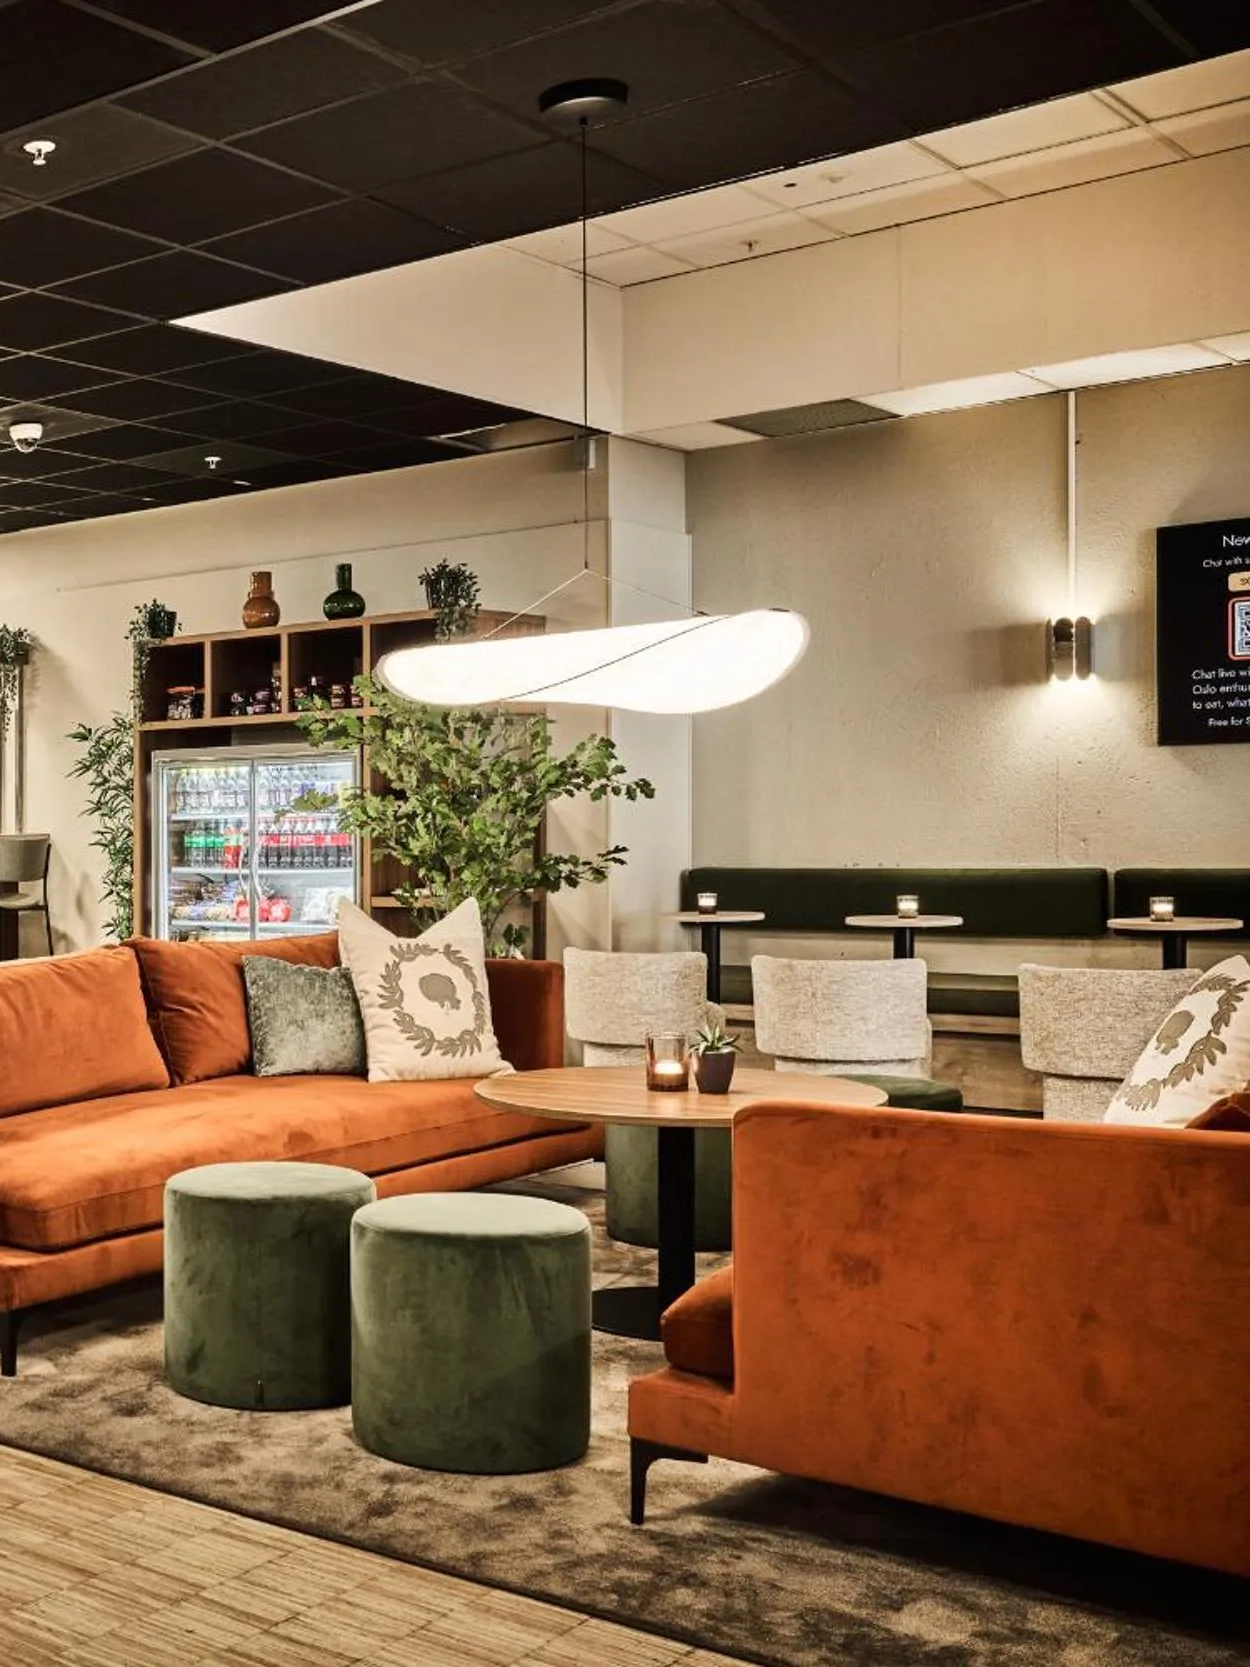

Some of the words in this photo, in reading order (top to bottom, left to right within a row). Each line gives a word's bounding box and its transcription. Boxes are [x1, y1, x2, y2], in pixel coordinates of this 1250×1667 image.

[1191, 669, 1216, 680] Chat
[1192, 684, 1217, 695] Oslo
[1192, 701, 1203, 710] to
